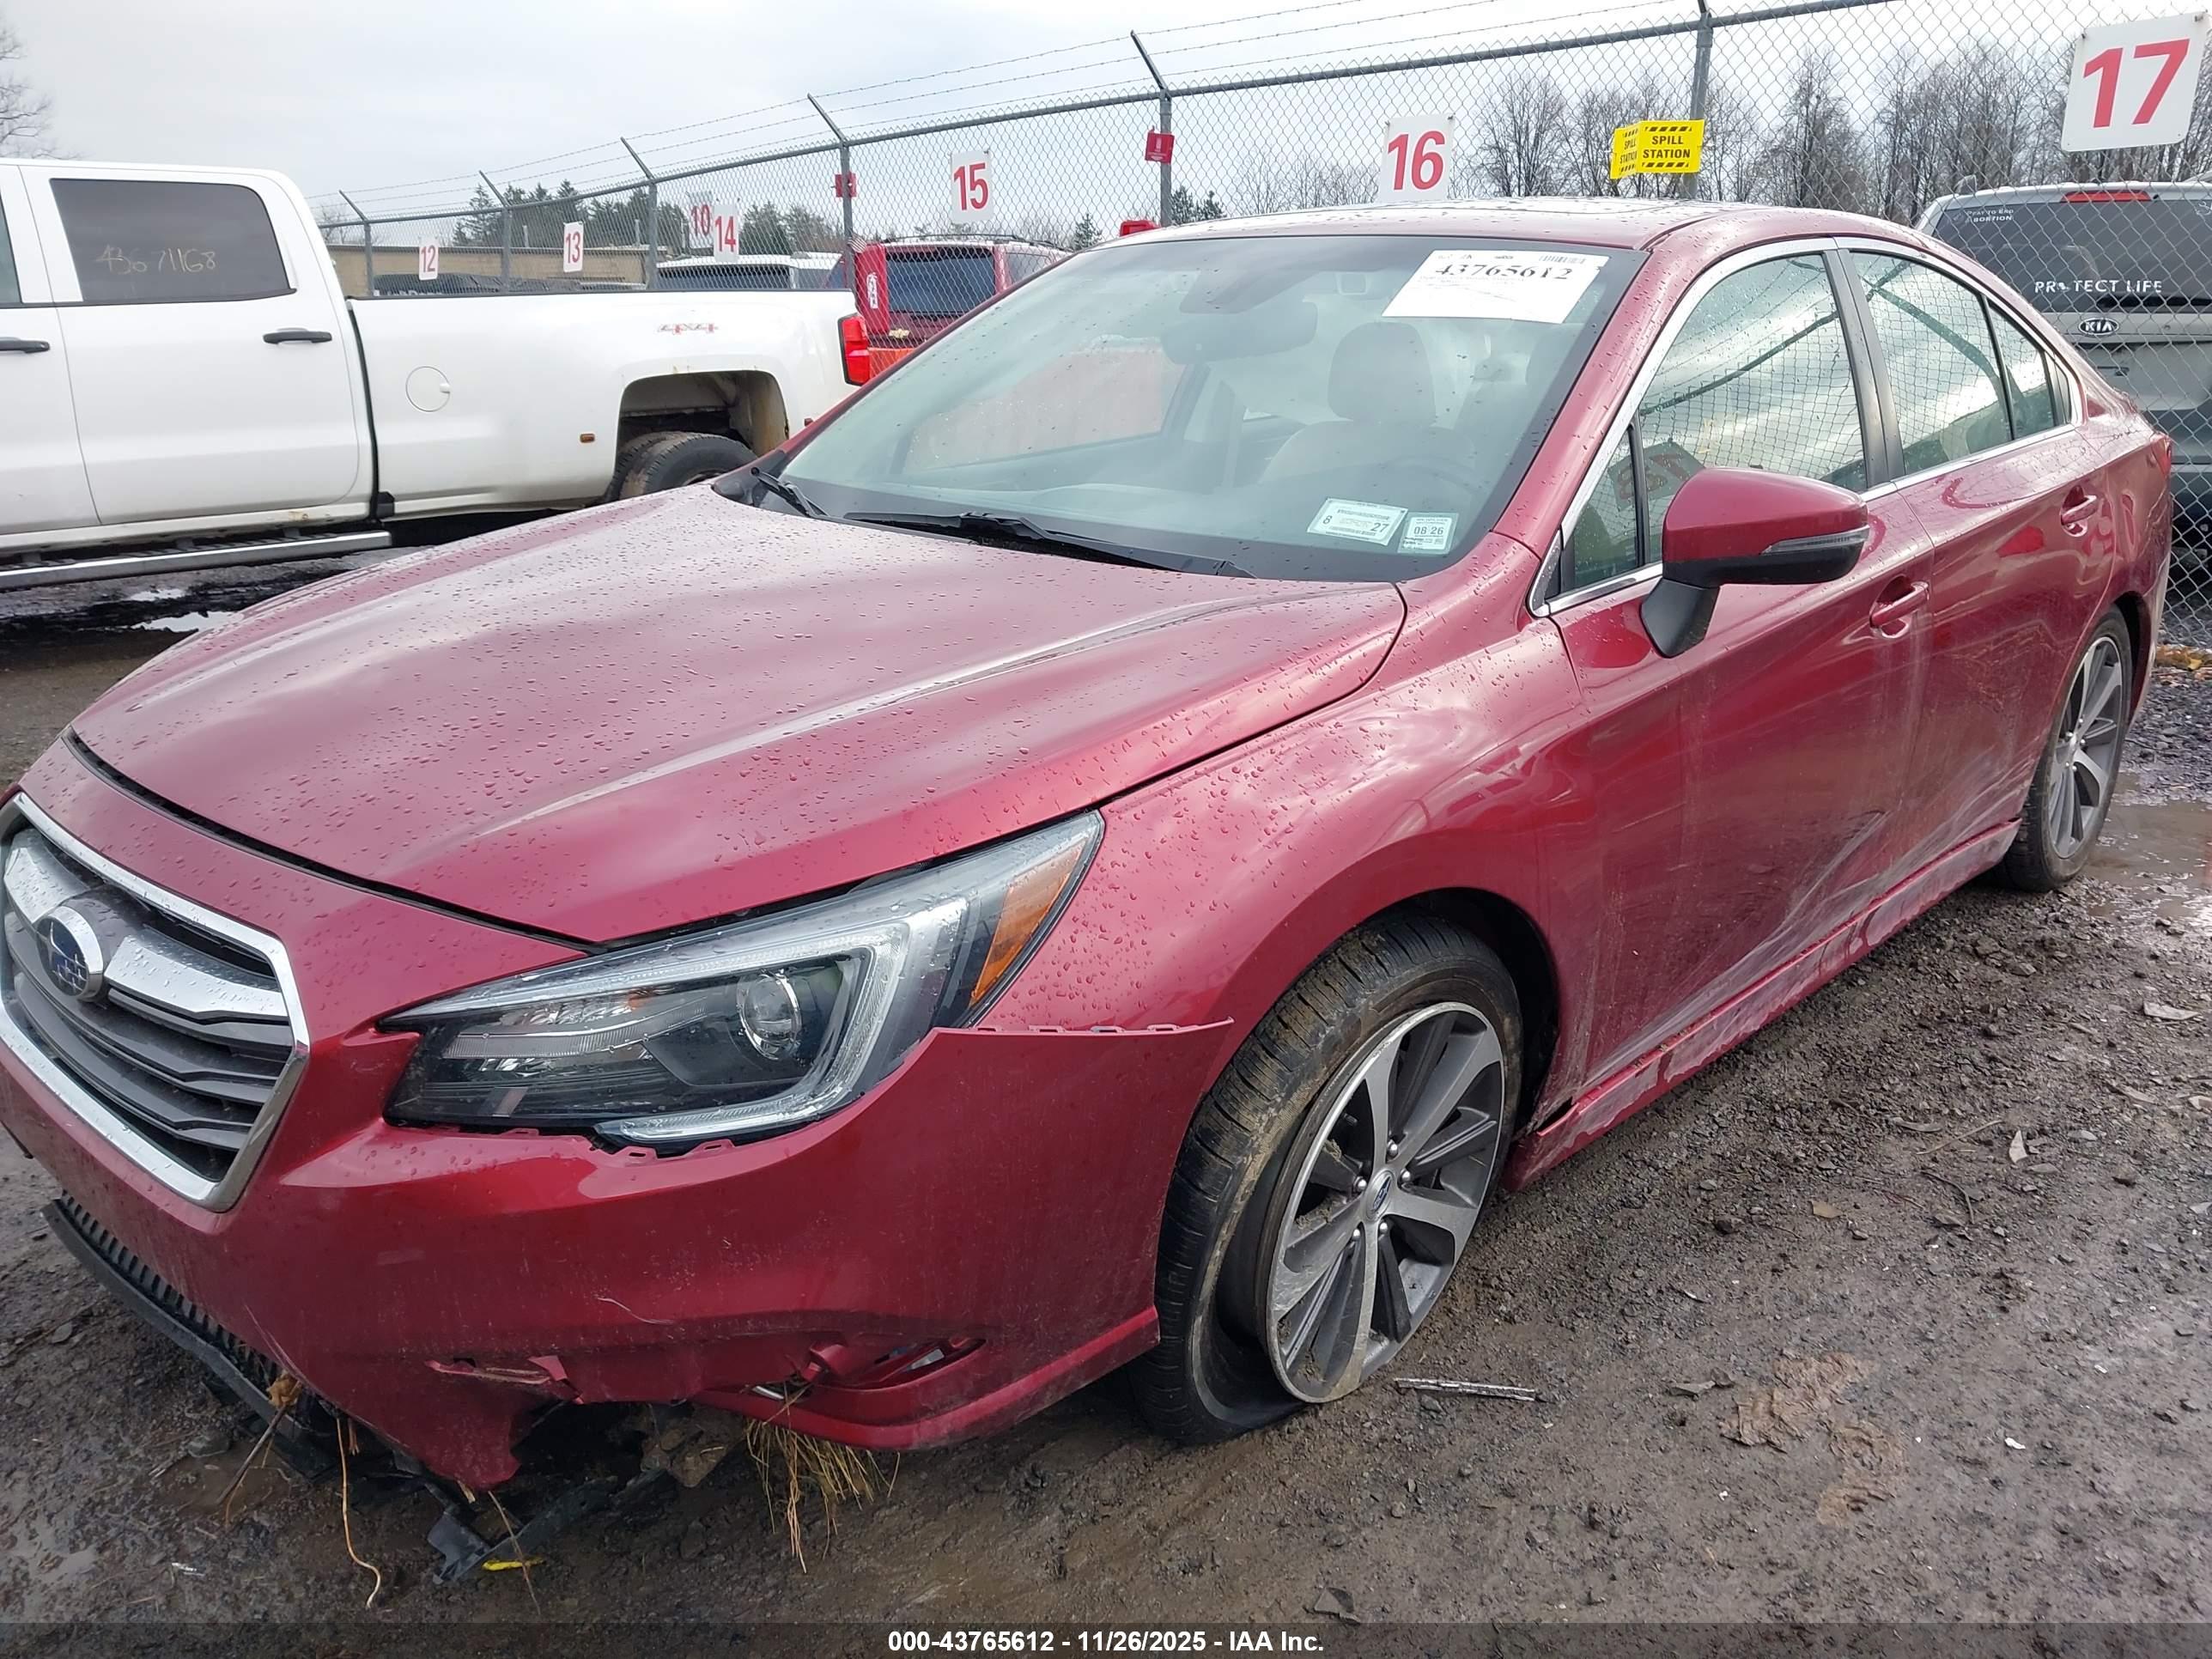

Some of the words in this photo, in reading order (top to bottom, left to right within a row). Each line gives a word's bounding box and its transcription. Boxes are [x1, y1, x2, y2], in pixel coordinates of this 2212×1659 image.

[2083, 39, 2191, 128] 17
[1642, 149, 1690, 159] STATION
[1651, 136, 1683, 145] SPILL
[1388, 131, 1445, 190] 16
[953, 162, 989, 211] 15
[565, 231, 581, 264] 13
[714, 216, 737, 252] 14
[421, 245, 436, 273] 12
[1435, 264, 1574, 280] 43765612
[2126, 280, 2163, 293] LIFE
[1370, 522, 1389, 532] 27
